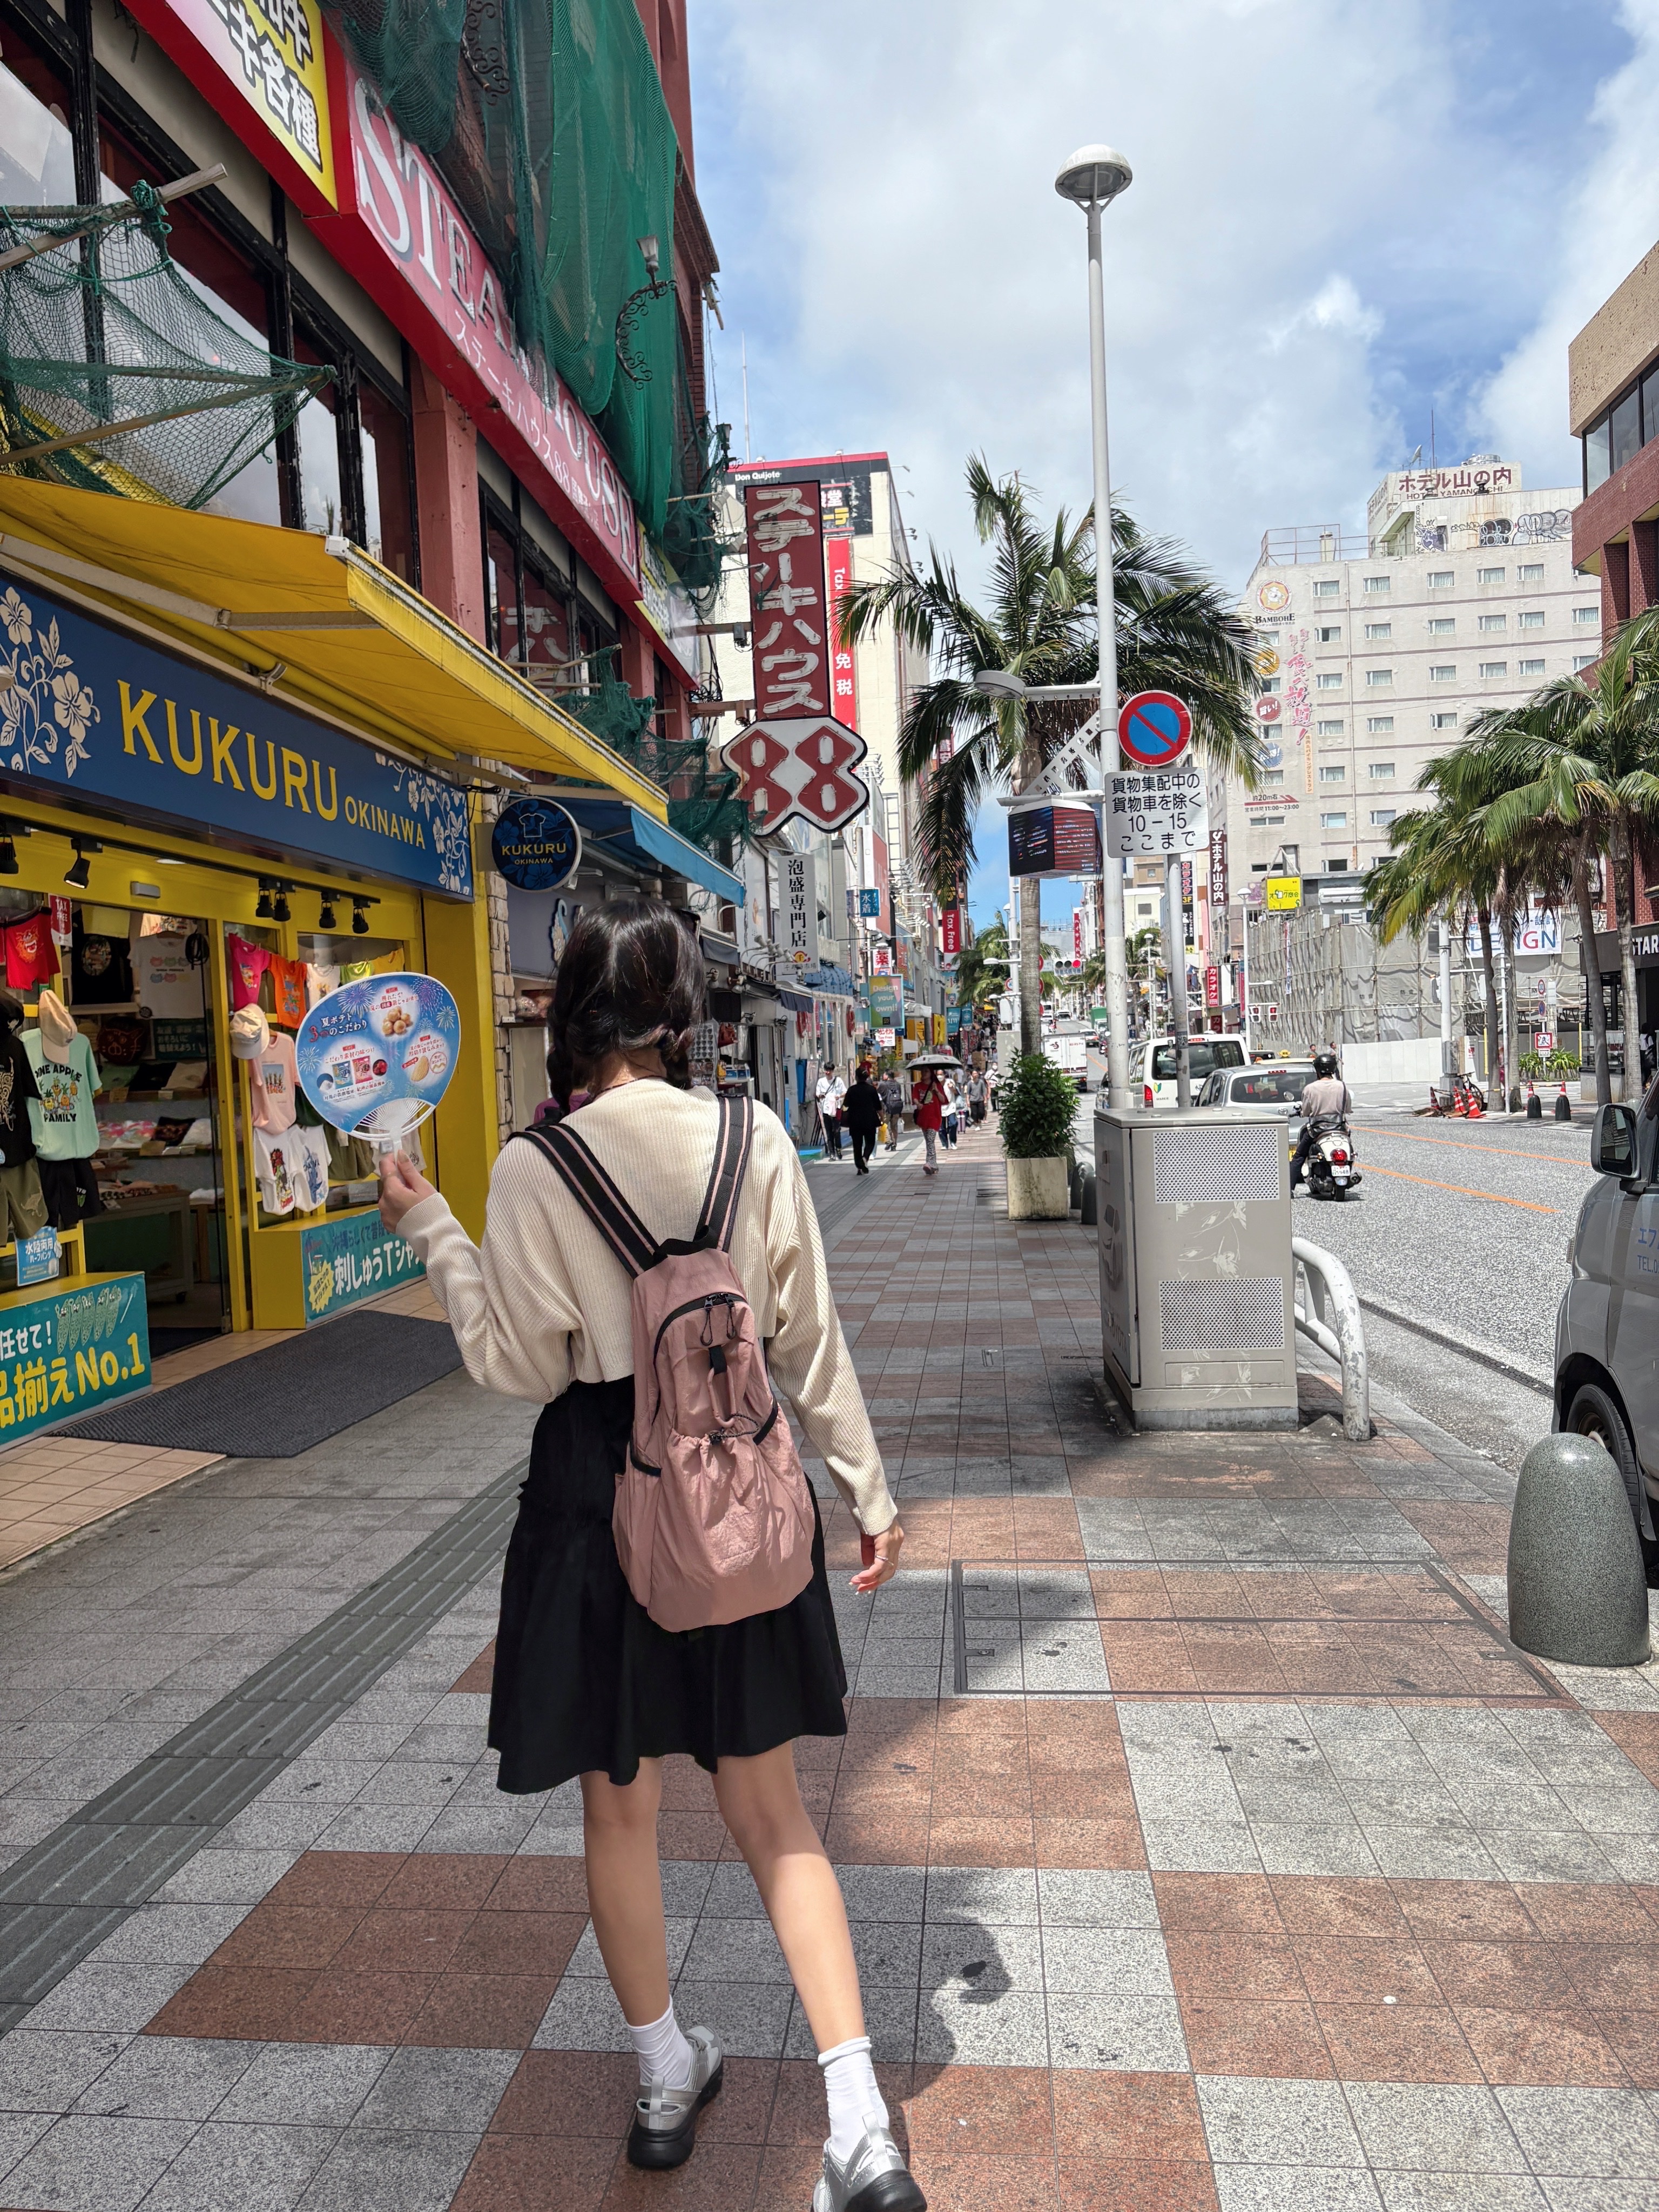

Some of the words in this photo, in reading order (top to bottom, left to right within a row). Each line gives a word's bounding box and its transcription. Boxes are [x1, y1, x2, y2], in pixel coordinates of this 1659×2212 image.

[210, 0, 322, 171] 牛各種
[735, 473, 750, 481] Don
[752, 471, 780, 480] Quijote
[1399, 467, 1511, 492] ホテル山の内
[753, 488, 824, 714] ステーキハウス
[1255, 613, 1296, 624] BAMBOHE
[835, 652, 853, 696] 免税
[117, 679, 338, 822] KUKURU
[345, 795, 426, 850] OKINAWA
[1111, 773, 1201, 794] 貨物集配中の
[1112, 792, 1202, 814] 貨物車を除く
[502, 843, 566, 855] KUKURU
[1121, 831, 1196, 852] ここまで
[1212, 844, 1224, 902] ホテル山の内
[56, 899, 67, 912] TAX
[788, 859, 807, 948] 泡盛専門店
[861, 893, 871, 913] 水着
[1469, 930, 1556, 952] DEIGN
[872, 984, 898, 993] Design
[1209, 968, 1217, 999] カラオケ
[875, 1003, 898, 1012] own!!
[877, 995, 895, 1003] your
[321, 1013, 353, 1028] 夏ポテト
[53, 1063, 82, 1082] APPLE
[44, 1112, 77, 1122] FAMILY
[25, 1237, 53, 1255] 水陸両用
[334, 1240, 420, 1296] 刺しゅうTシャ
